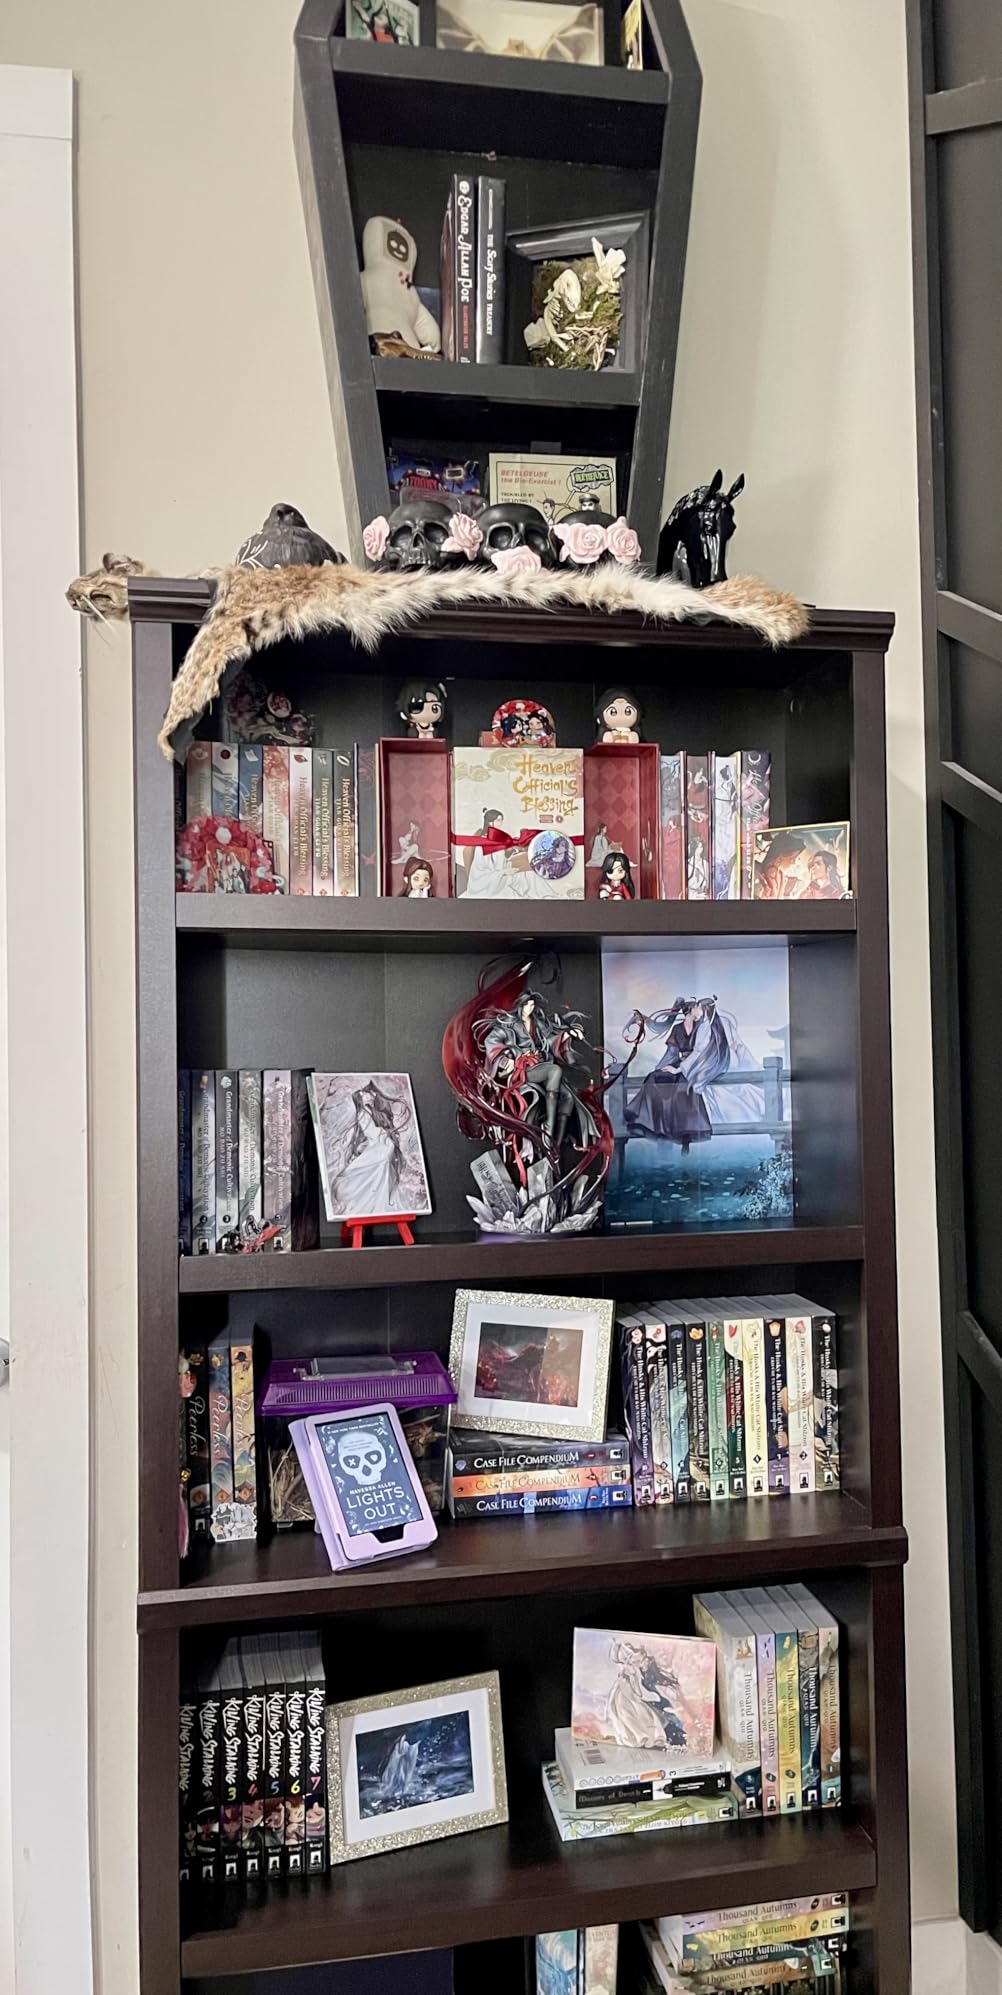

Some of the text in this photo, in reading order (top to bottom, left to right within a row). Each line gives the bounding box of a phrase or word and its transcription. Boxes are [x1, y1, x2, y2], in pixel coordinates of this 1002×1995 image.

[457, 234, 473, 277] ALLAN
[484, 249, 497, 273] Scary
[457, 277, 473, 303] POE
[486, 272, 497, 300] Stories
[513, 755, 577, 777] Heaven
[512, 777, 578, 796] Official's
[520, 796, 579, 816] Blessing
[320, 778, 330, 877] Heaven Official's Blessing
[341, 778, 351, 877] Heaven Official's Blessing
[225, 1091, 233, 1135] Grandmaster
[225, 1143, 233, 1172] Demonic
[676, 1357, 684, 1378] Husky
[695, 1357, 703, 1378] Husky
[774, 1351, 782, 1372] Husky
[735, 1395, 743, 1415] White
[189, 1396, 207, 1456] Peerless
[210, 1395, 229, 1455] Peerless
[474, 1457, 497, 1469] CASE
[498, 1456, 516, 1467] FILE
[516, 1451, 580, 1465] COMPENDIUM
[377, 1481, 396, 1490] ALLEN
[475, 1480, 498, 1491] CASE
[518, 1474, 580, 1488] COMPENDIUM
[346, 1486, 405, 1509] LIGHTS
[364, 1502, 396, 1520] OUT
[476, 1494, 582, 1511] CASE FILE COMPENDIUM
[744, 1673, 754, 1716] Thousand
[808, 1666, 818, 1710] Thousand
[199, 1700, 220, 1740] KILLING
[766, 1671, 777, 1758] Thousand Autumns
[787, 1668, 797, 1754] Thousand Autumns
[829, 1665, 838, 1749] Thousand Autumns
[222, 1697, 243, 1801] KILLING STALKING 3
[243, 1694, 263, 1795] KILLING STALKING 4
[266, 1691, 286, 1794] KILLING STALKING 5
[286, 1691, 306, 1794] KILLING STALKING 6
[306, 1687, 326, 1791] KILLING STALKING 7
[200, 1738, 218, 1787] STALKING
[718, 1902, 797, 1921] Thousand Autumns
[718, 1928, 758, 1943] Thousand
[760, 1923, 797, 1936] Autumns
[713, 1946, 754, 1961] Thousand
[706, 1970, 746, 1985] Thousand
